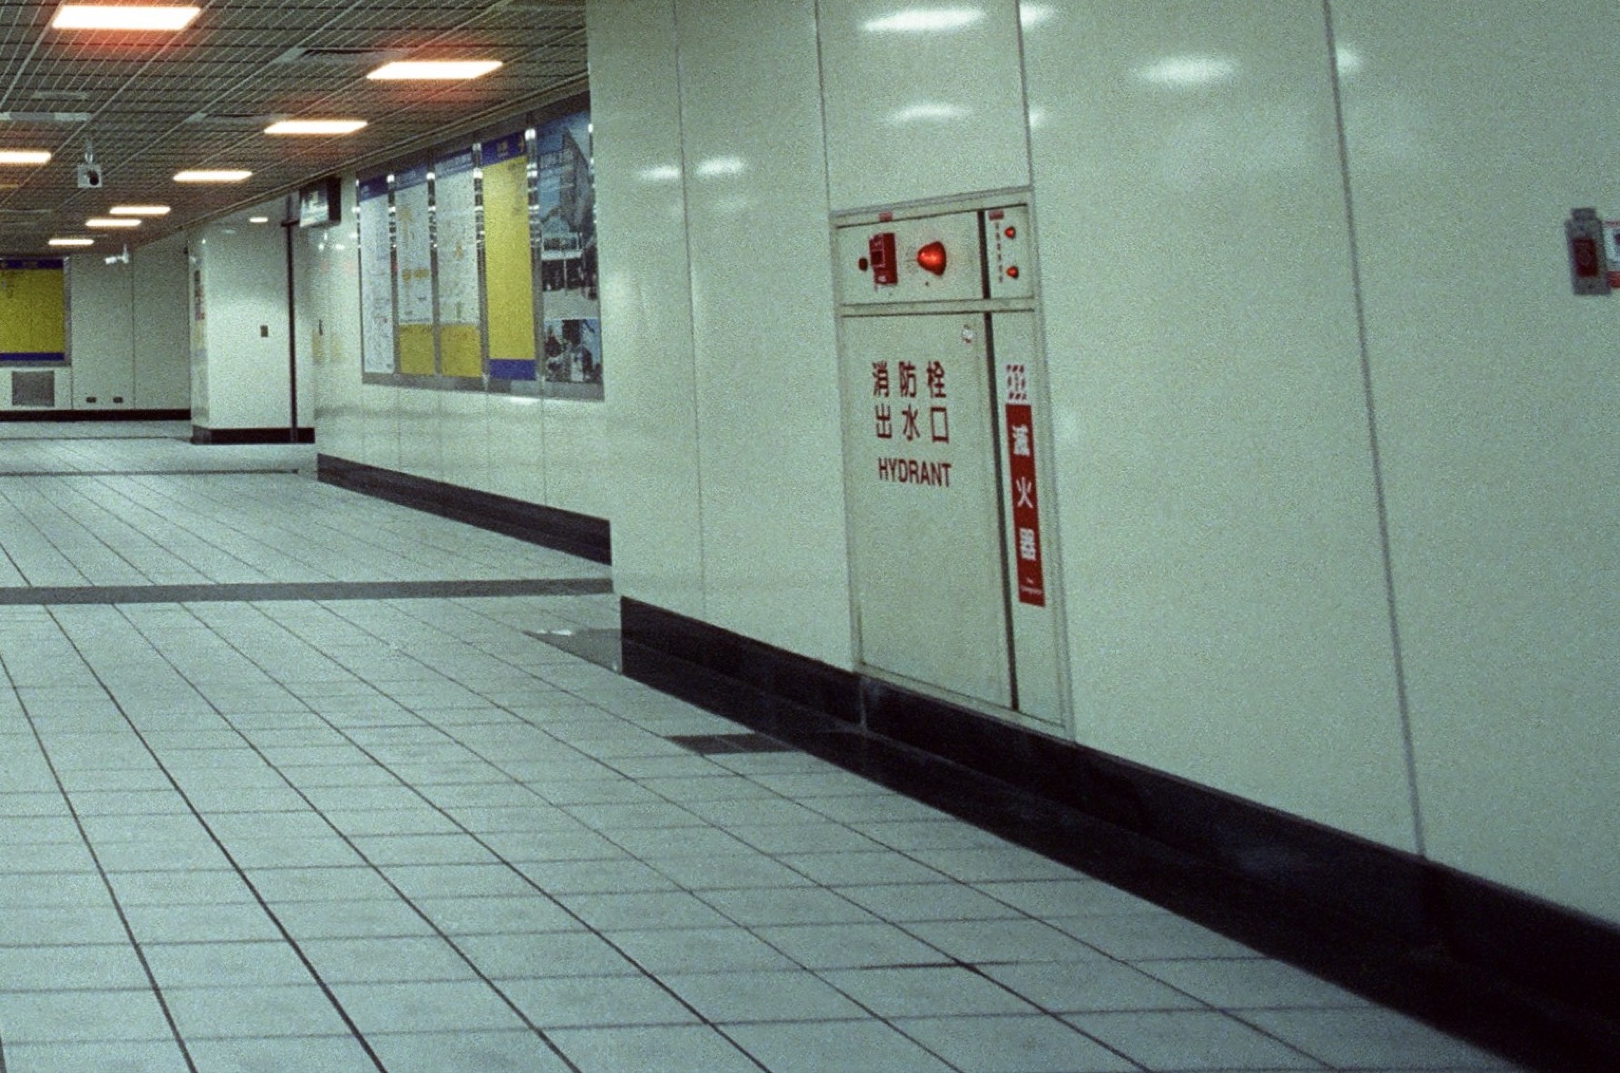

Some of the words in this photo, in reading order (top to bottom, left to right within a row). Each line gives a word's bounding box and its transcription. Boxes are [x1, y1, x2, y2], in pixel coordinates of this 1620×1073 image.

[872, 360, 947, 398] 消防栓
[875, 403, 949, 443] 出水口
[878, 457, 952, 487] HYDRANT
